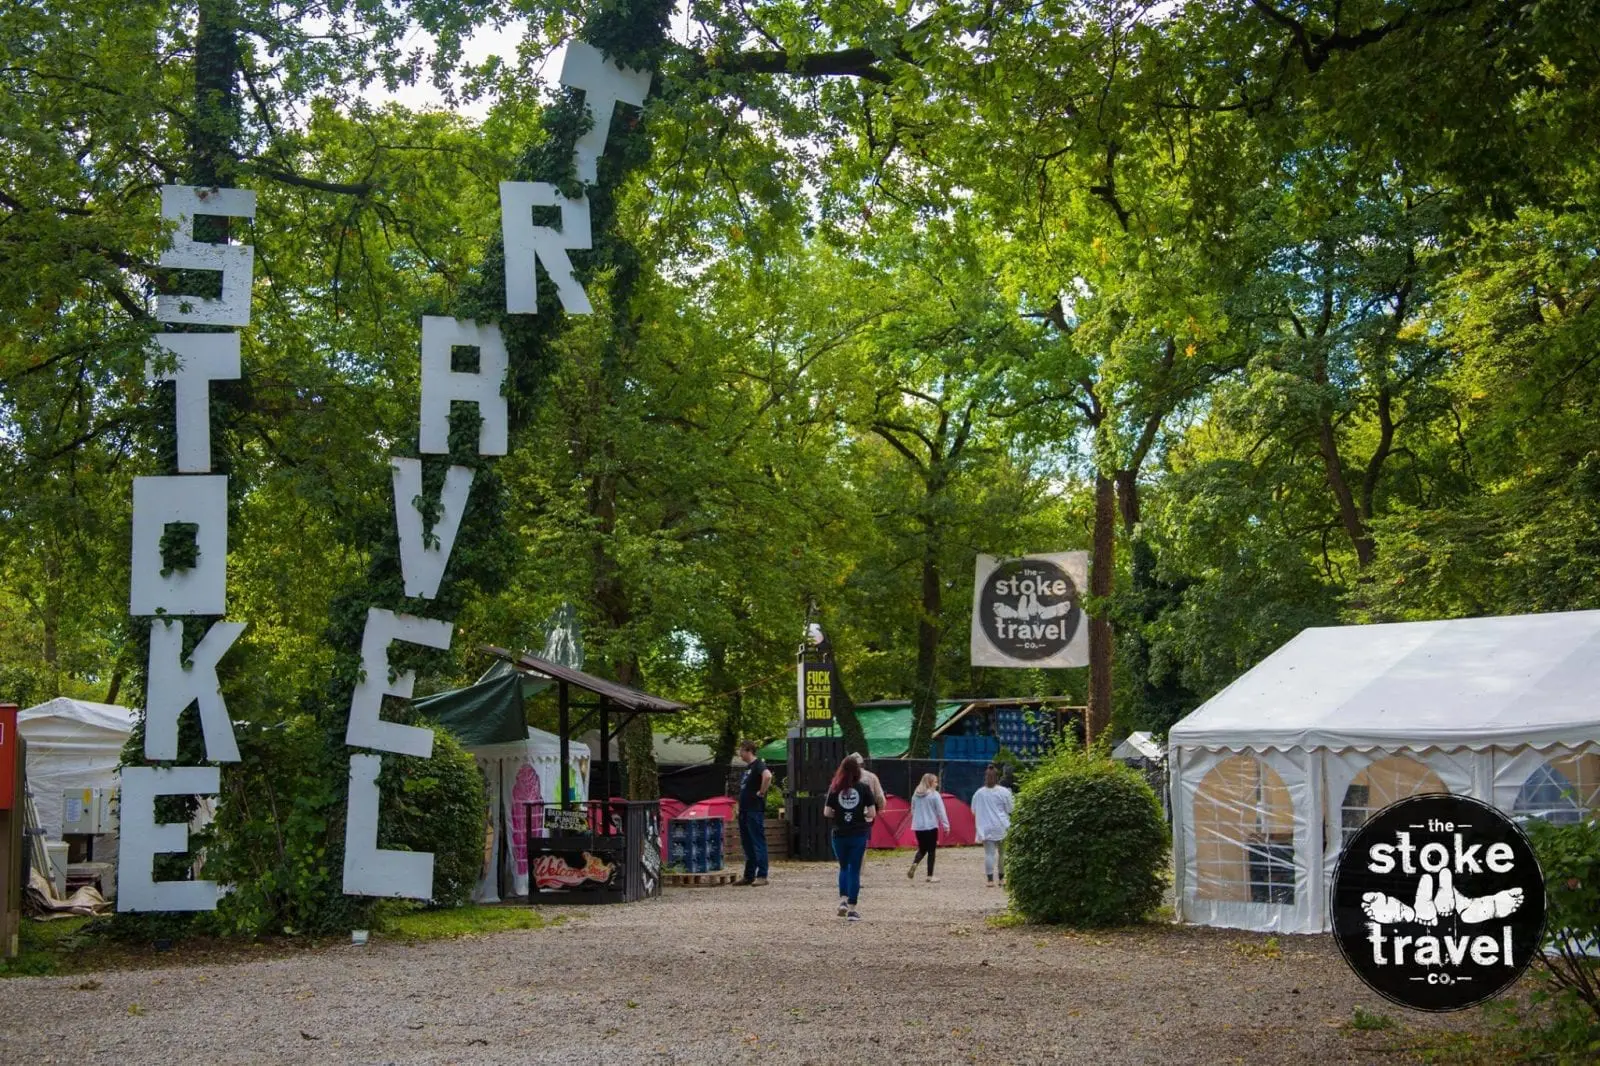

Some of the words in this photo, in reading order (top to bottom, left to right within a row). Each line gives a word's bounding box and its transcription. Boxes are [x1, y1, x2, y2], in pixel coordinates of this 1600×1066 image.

[343, 39, 653, 900] TRAVEL
[116, 184, 257, 913] STOKE
[1023, 569, 1038, 577] the
[995, 575, 1067, 596] stoke
[994, 616, 1067, 640] travel
[806, 670, 831, 685] FUCK
[806, 684, 831, 692] CALM
[806, 695, 832, 709] GET
